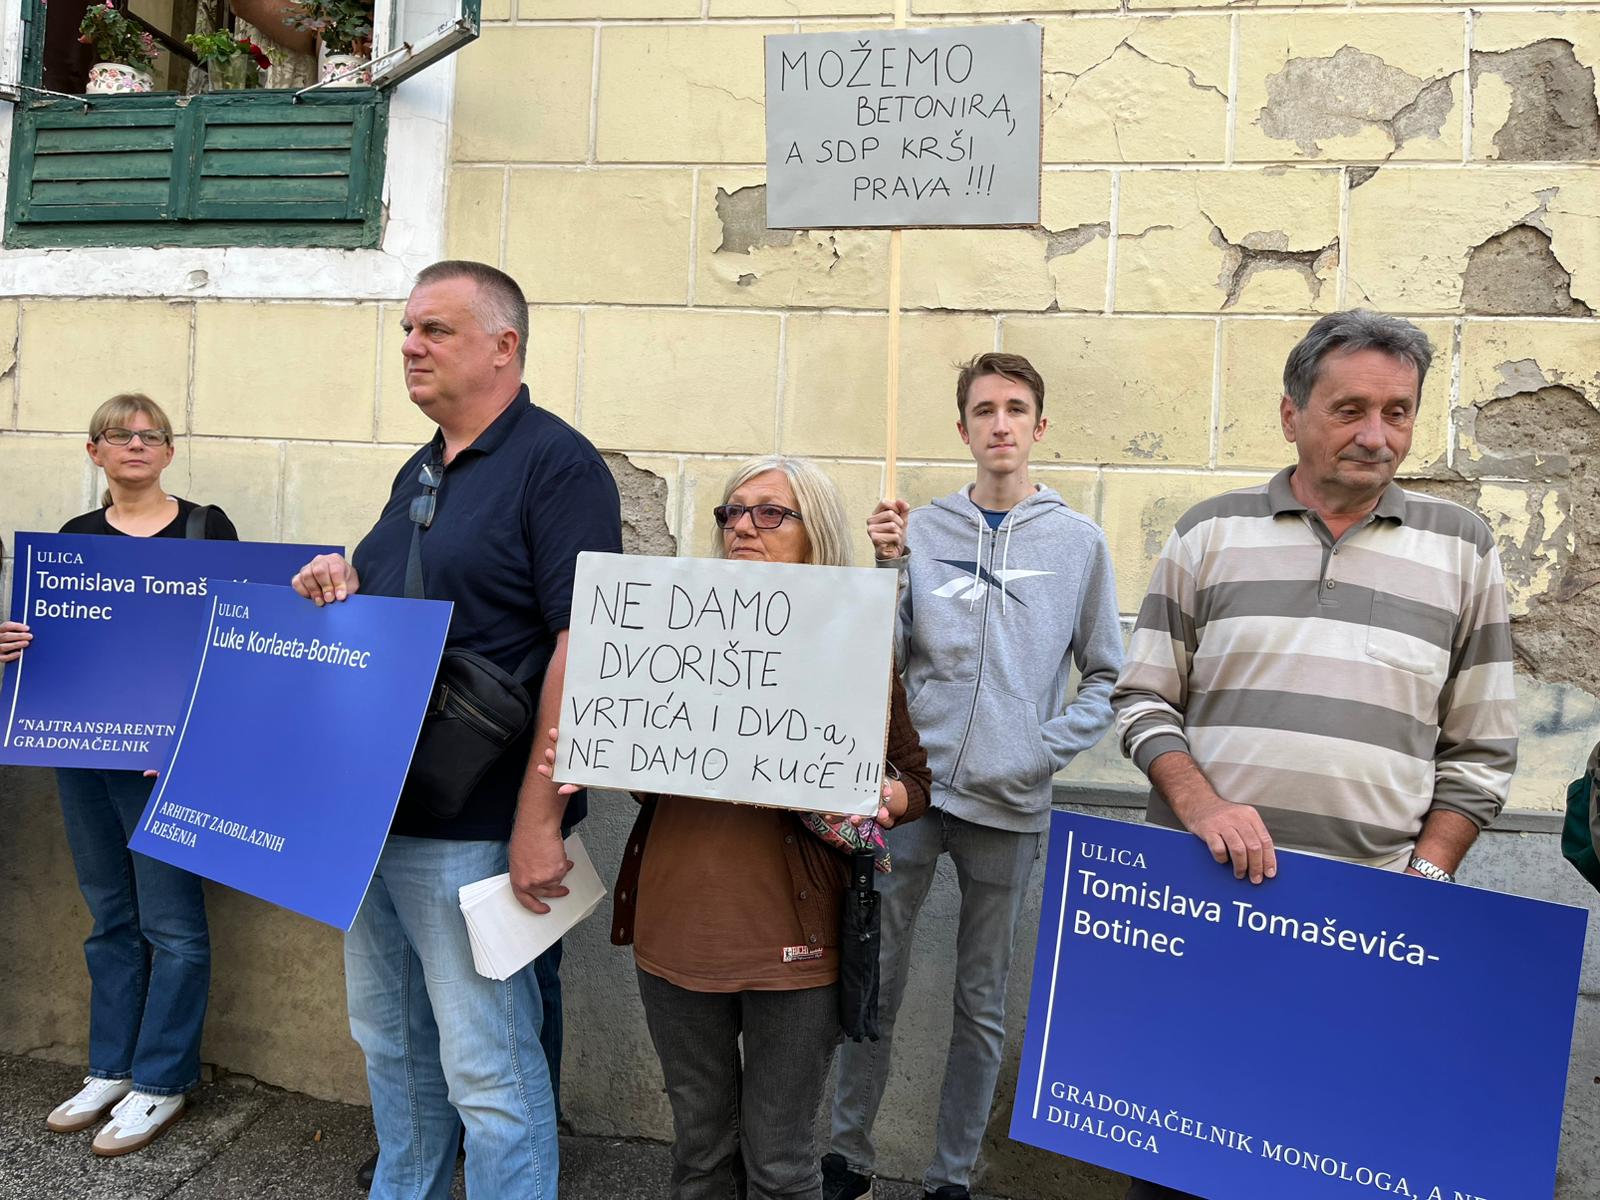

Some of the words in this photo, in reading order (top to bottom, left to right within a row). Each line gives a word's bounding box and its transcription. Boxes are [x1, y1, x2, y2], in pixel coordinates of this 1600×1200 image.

[781, 40, 973, 91] MOŽEMO
[857, 94, 1016, 135] BETONIRA,
[785, 141, 803, 164] A
[816, 137, 880, 163] SDP
[901, 129, 973, 161] KRŠI
[854, 176, 950, 201] PRAVA
[37, 552, 84, 564] ULICA
[37, 571, 135, 593] Tomislava
[35, 600, 112, 620] Botinec
[218, 603, 249, 619] ULICA
[591, 582, 652, 629] NE
[668, 585, 791, 636] DAMO
[212, 625, 244, 650] Luke
[246, 627, 371, 669] Korlaeta-Botinec
[600, 641, 782, 689] DVORIŠTE
[13, 736, 150, 752] GRADONAČELNIK
[572, 692, 692, 731] VRTIĆA
[712, 706, 719, 732] I
[738, 706, 856, 755] DVD-a,
[568, 738, 614, 770] NE
[631, 744, 728, 780] DAMO
[752, 753, 844, 789] KUĆE
[150, 820, 197, 848] RJEŠENJA
[158, 801, 210, 828] ARHITEKT
[209, 815, 286, 853] ZAOBILAZNIH
[1081, 842, 1147, 869] ULICA
[1073, 910, 1185, 957] Botinec
[1079, 870, 1221, 923] Tomislava
[1232, 901, 1440, 966] Tomaševića-
[1046, 1106, 1159, 1154] DIJALOGA
[1050, 1081, 1253, 1154] GRADONAČELNIK
[1260, 1139, 1418, 1200] MONOLOGA,
[1427, 1185, 1442, 1200] A
